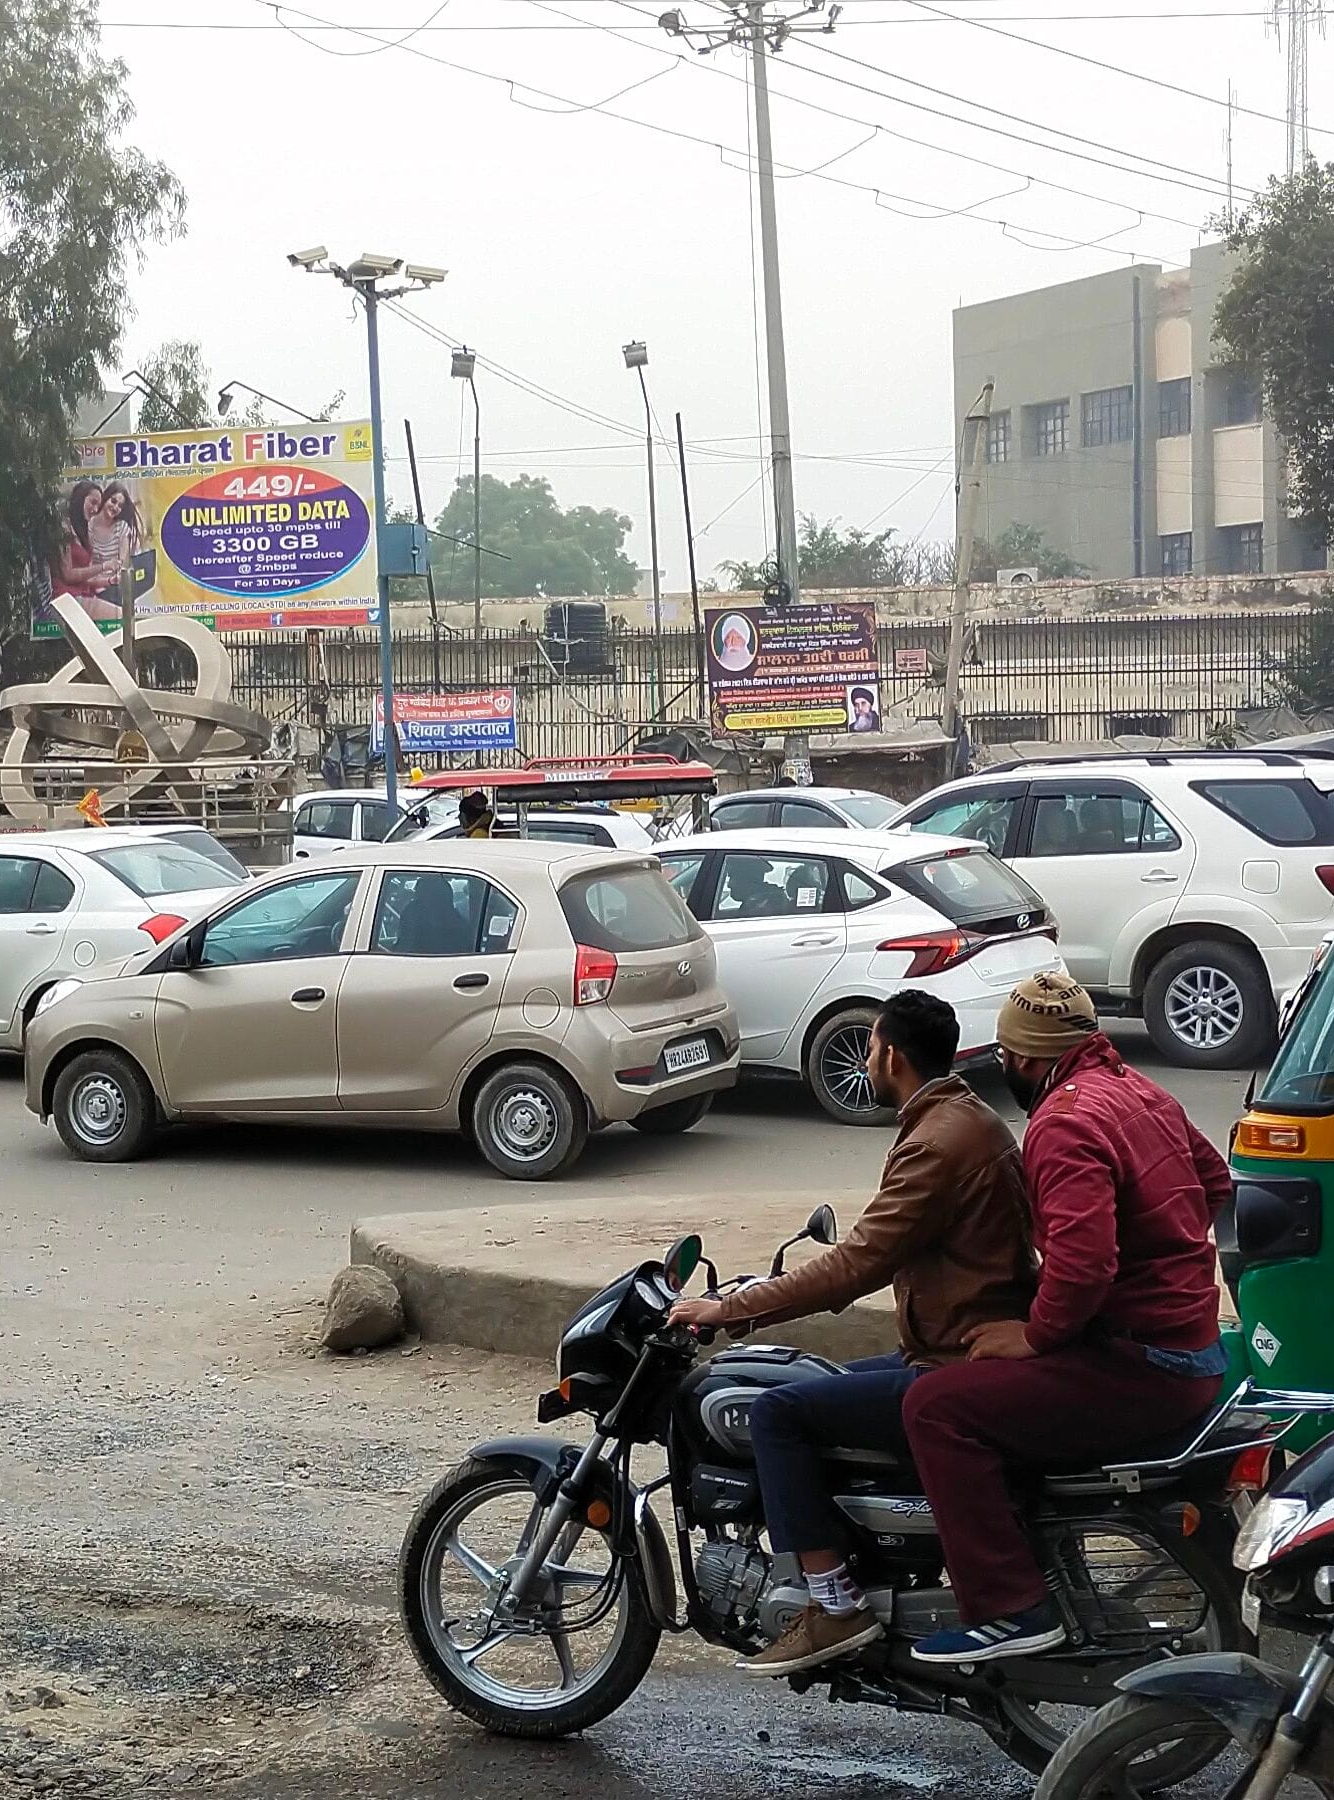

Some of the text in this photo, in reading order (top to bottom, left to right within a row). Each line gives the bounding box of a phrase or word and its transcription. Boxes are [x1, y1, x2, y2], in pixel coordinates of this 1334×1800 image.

[114, 431, 337, 468] Bharat Fiber
[349, 441, 370, 450] BSNL
[223, 473, 316, 499] 449/-
[181, 499, 351, 527] UNLIMITED DATA
[192, 526, 232, 538] Speed
[235, 525, 264, 536] upto
[267, 523, 283, 533] 30
[324, 520, 341, 530] till
[212, 533, 319, 554] 3300 GB
[192, 550, 344, 566] thereafter Speed reduce
[254, 563, 298, 573] 2mbps
[234, 578, 301, 588] For 30 Days
[154, 604, 190, 614] UNLIMITED
[192, 604, 208, 612] FREE
[210, 602, 240, 611] CALLING
[450, 721, 511, 737] अस्पताल
[1255, 1338, 1275, 1351] CNG
[891, 1500, 933, 1517] Sple
